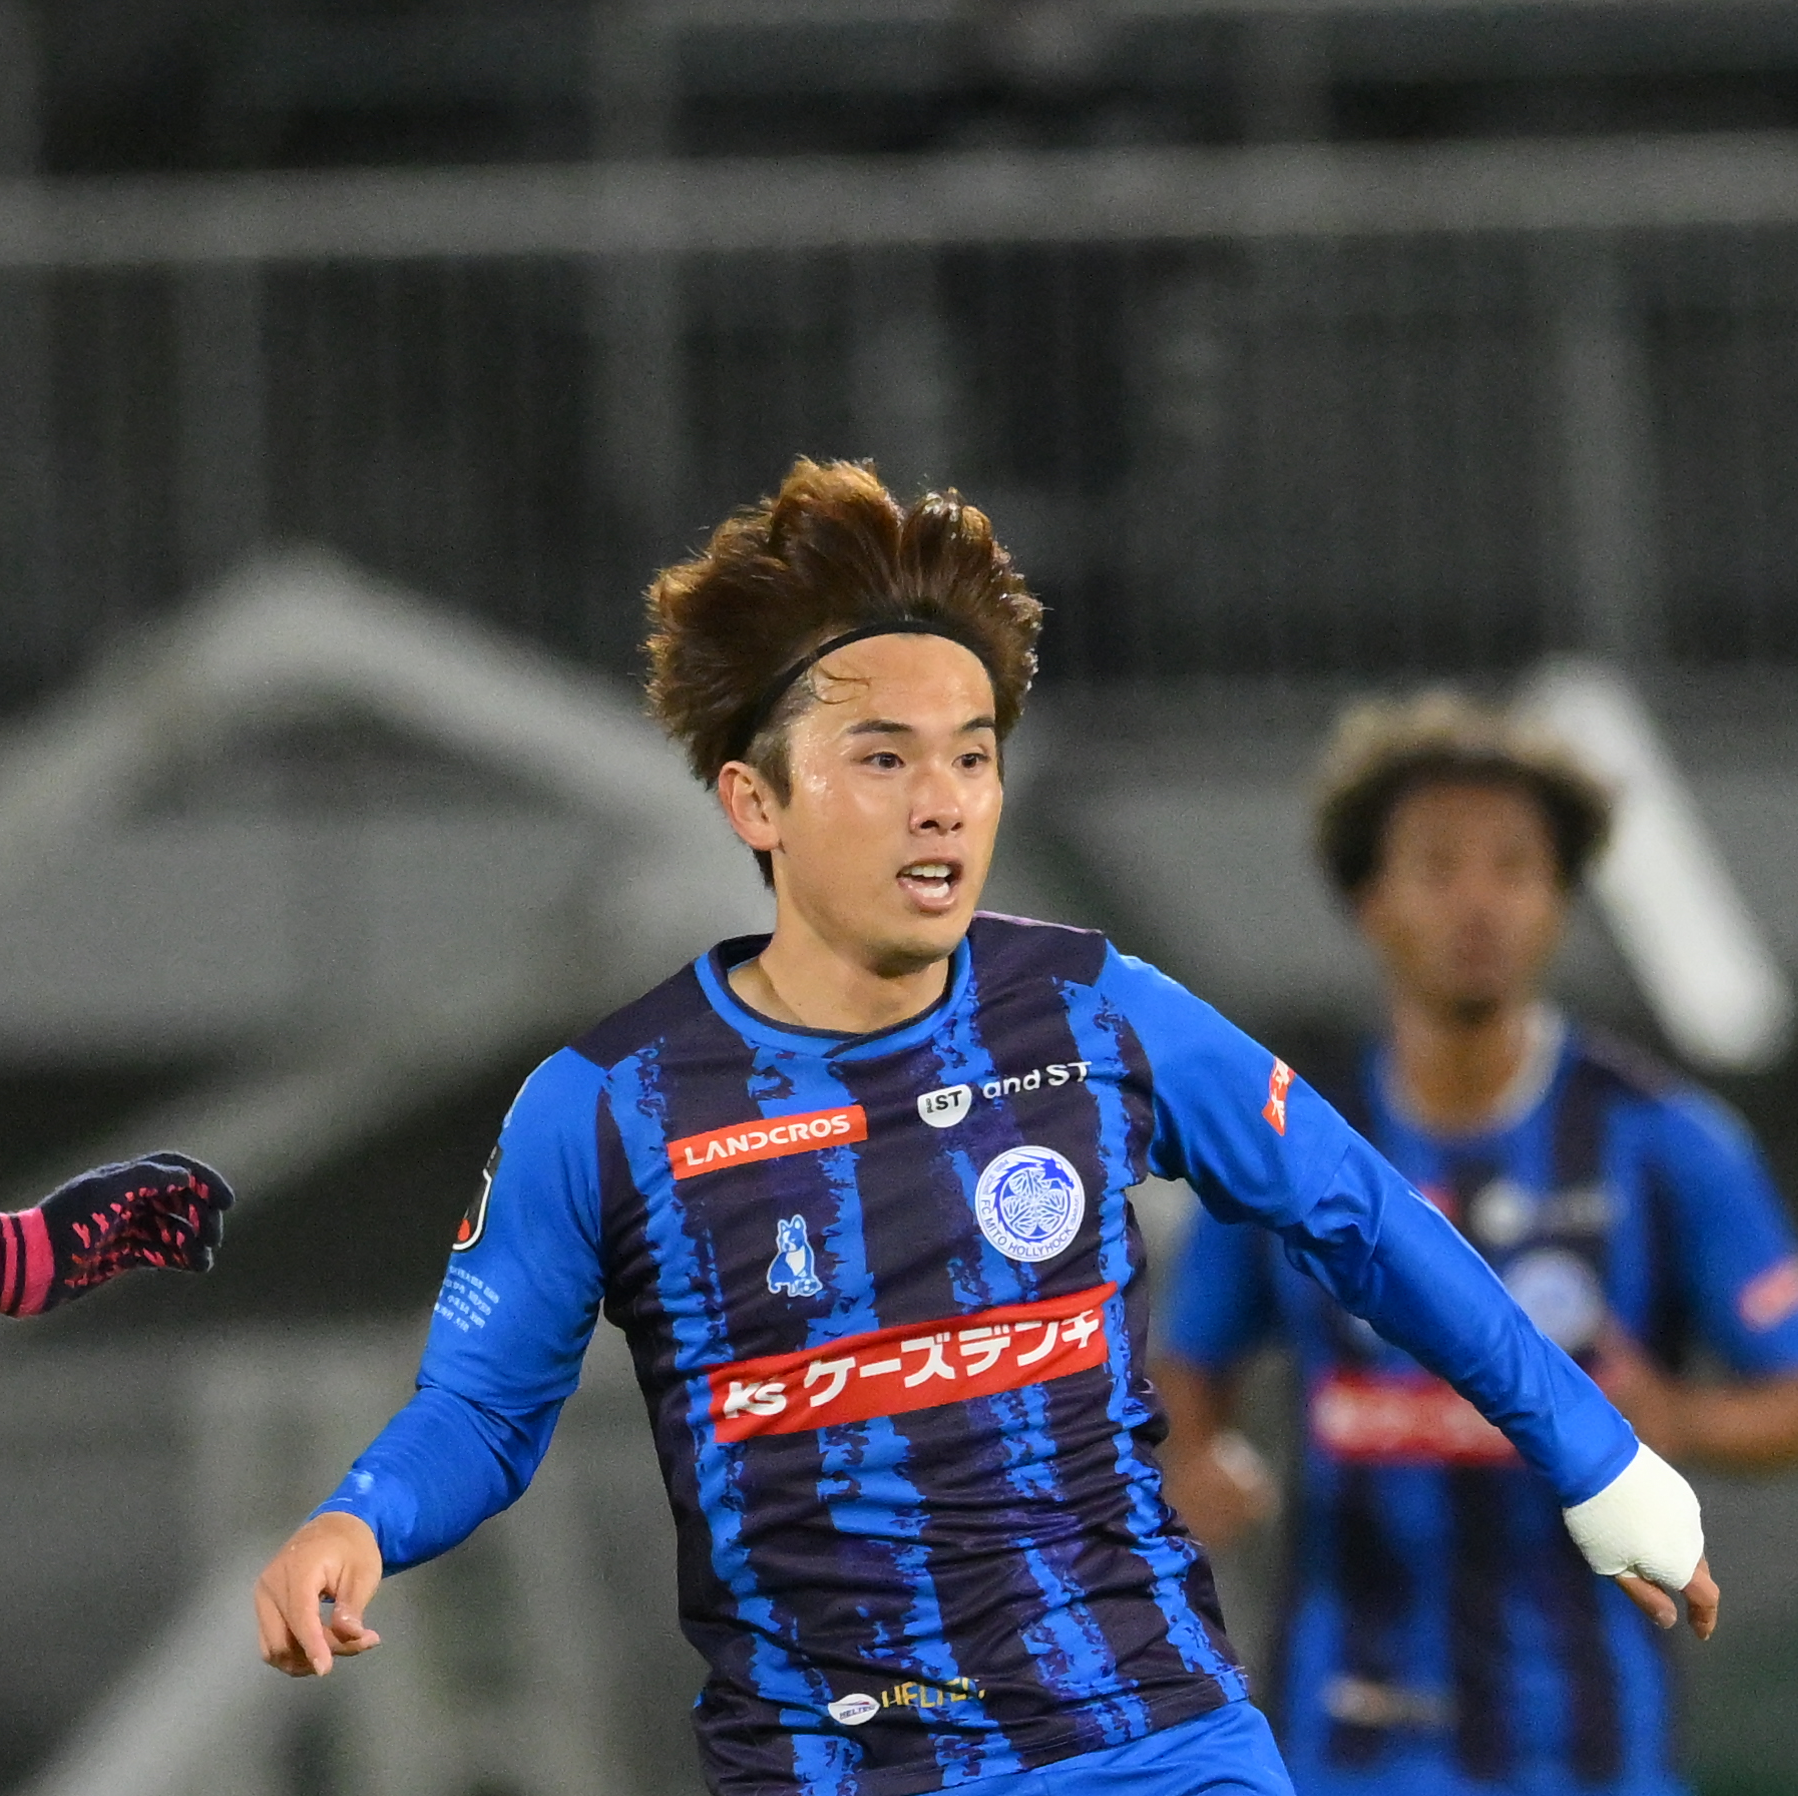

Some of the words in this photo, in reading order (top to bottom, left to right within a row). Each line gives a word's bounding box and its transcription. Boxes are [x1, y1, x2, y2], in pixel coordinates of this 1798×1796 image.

[983, 1069, 1041, 1099] and
[1046, 1061, 1092, 1086] ST
[935, 1089, 963, 1111] ST
[684, 1114, 851, 1167] LANDCROS
[980, 1199, 992, 1215] FC
[984, 1217, 1008, 1246] MITO
[1008, 1226, 1073, 1257] HOLLYHOCK
[803, 1308, 1100, 1408] ケーズデンキ
